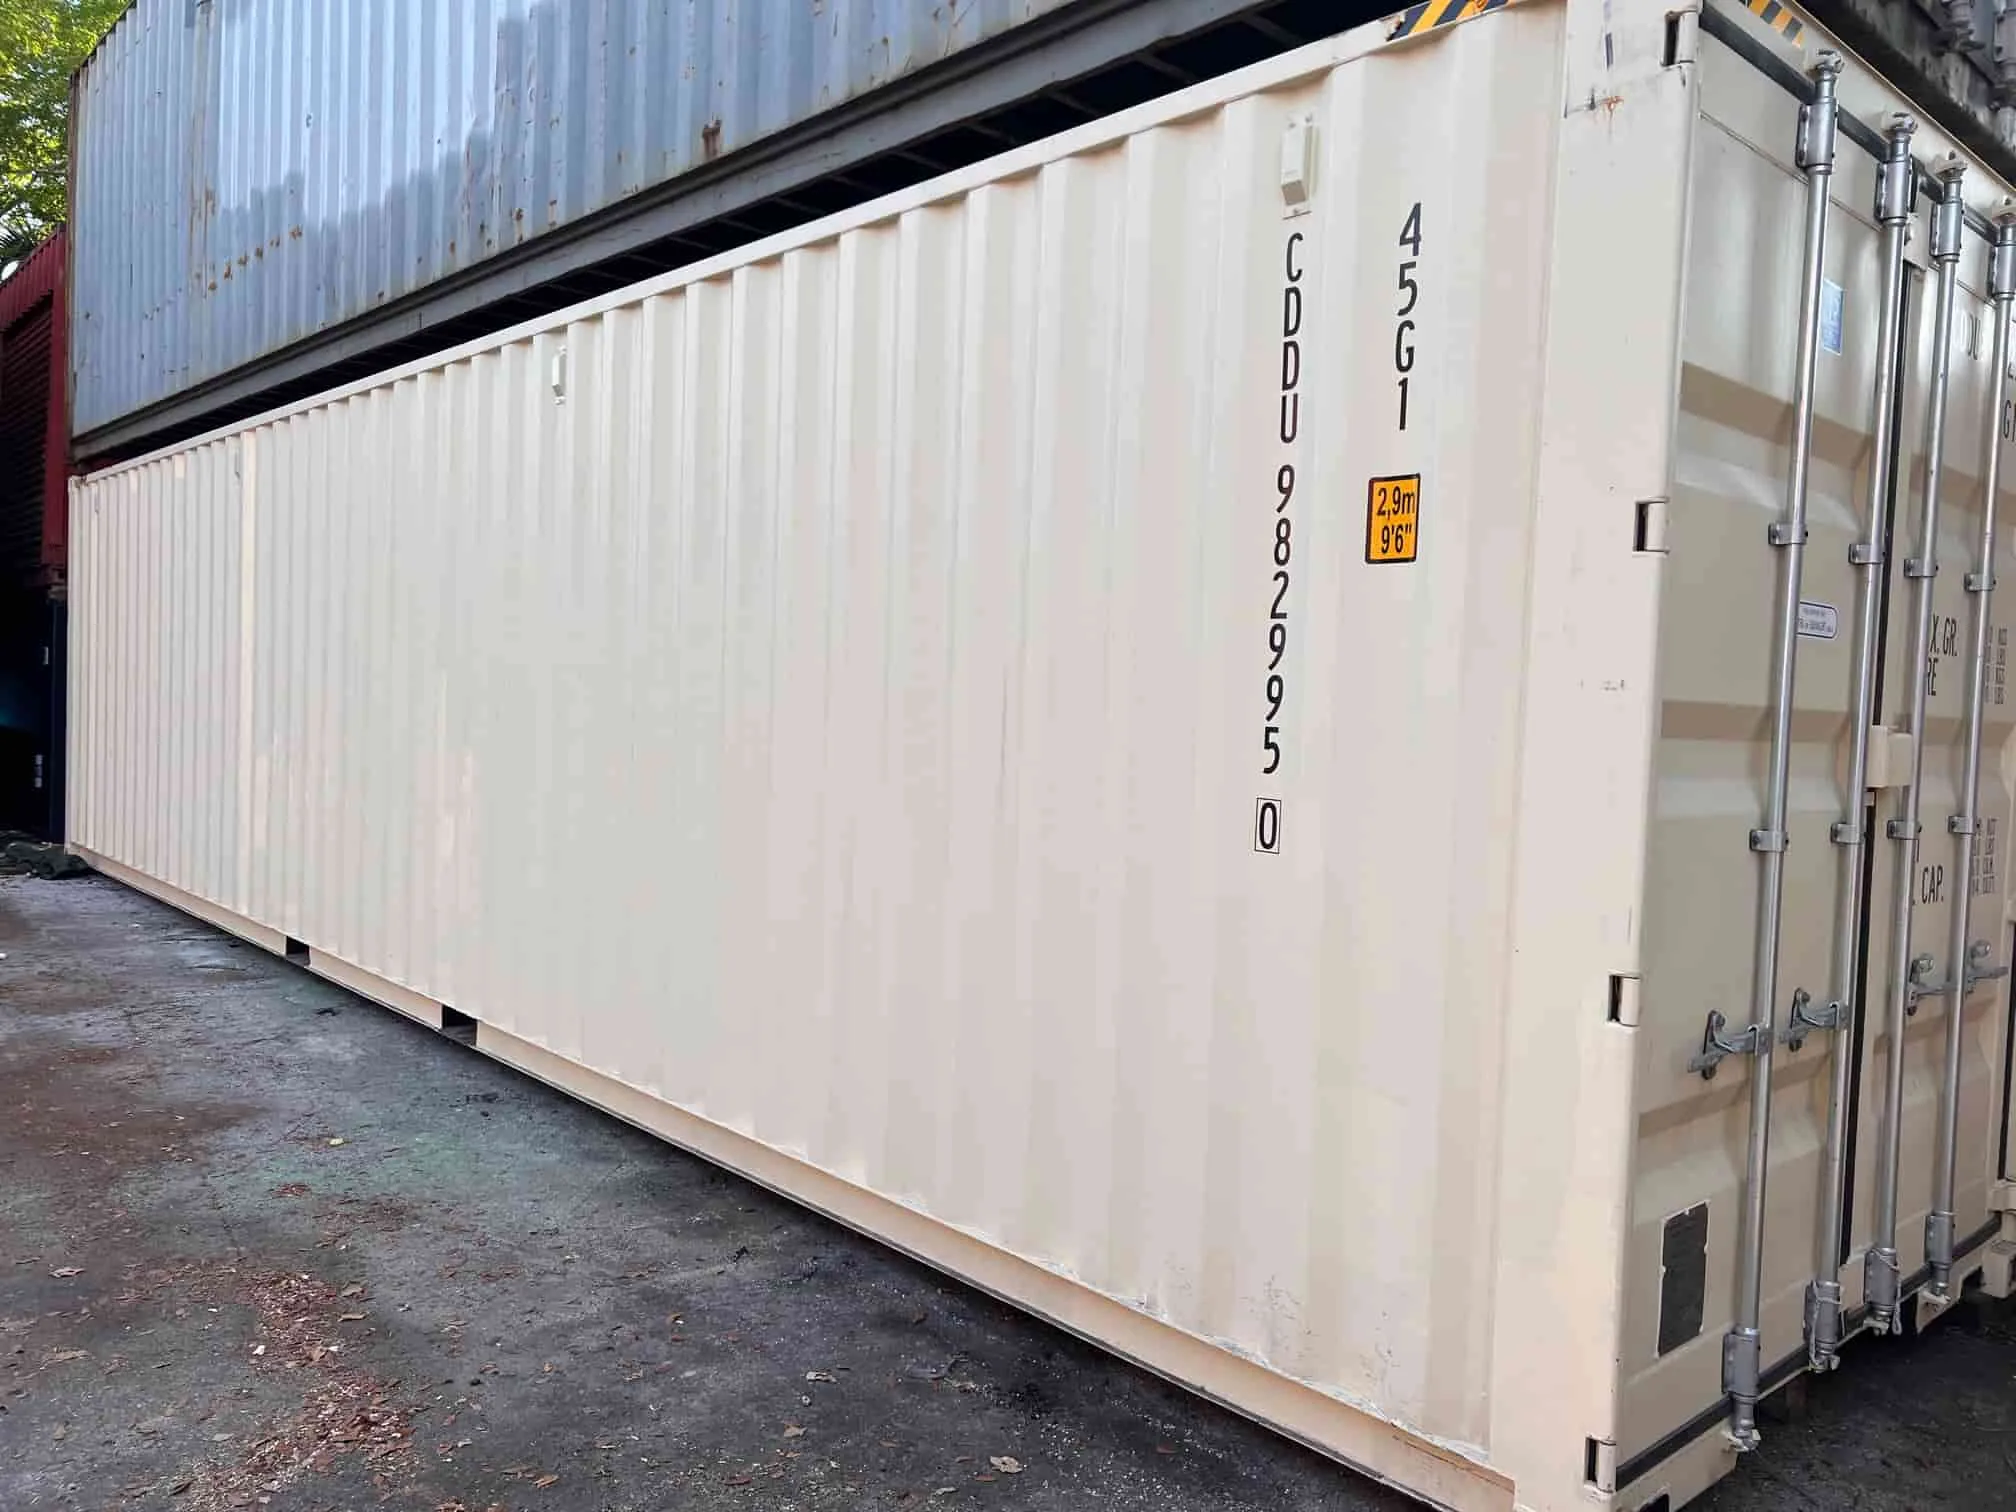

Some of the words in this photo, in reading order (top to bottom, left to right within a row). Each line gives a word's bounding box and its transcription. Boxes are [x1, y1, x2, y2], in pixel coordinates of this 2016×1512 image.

[1280, 232, 1304, 443] CDDU
[1395, 202, 1422, 431] 45G1
[1377, 486, 1415, 520] 2,9m
[1382, 523, 1412, 554] 9'6"
[1263, 464, 1295, 774] 982995
[1929, 613, 1940, 655] X.
[1943, 616, 1958, 656] GR.
[1258, 801, 1278, 850] 0
[1921, 864, 1944, 904] CAP.
